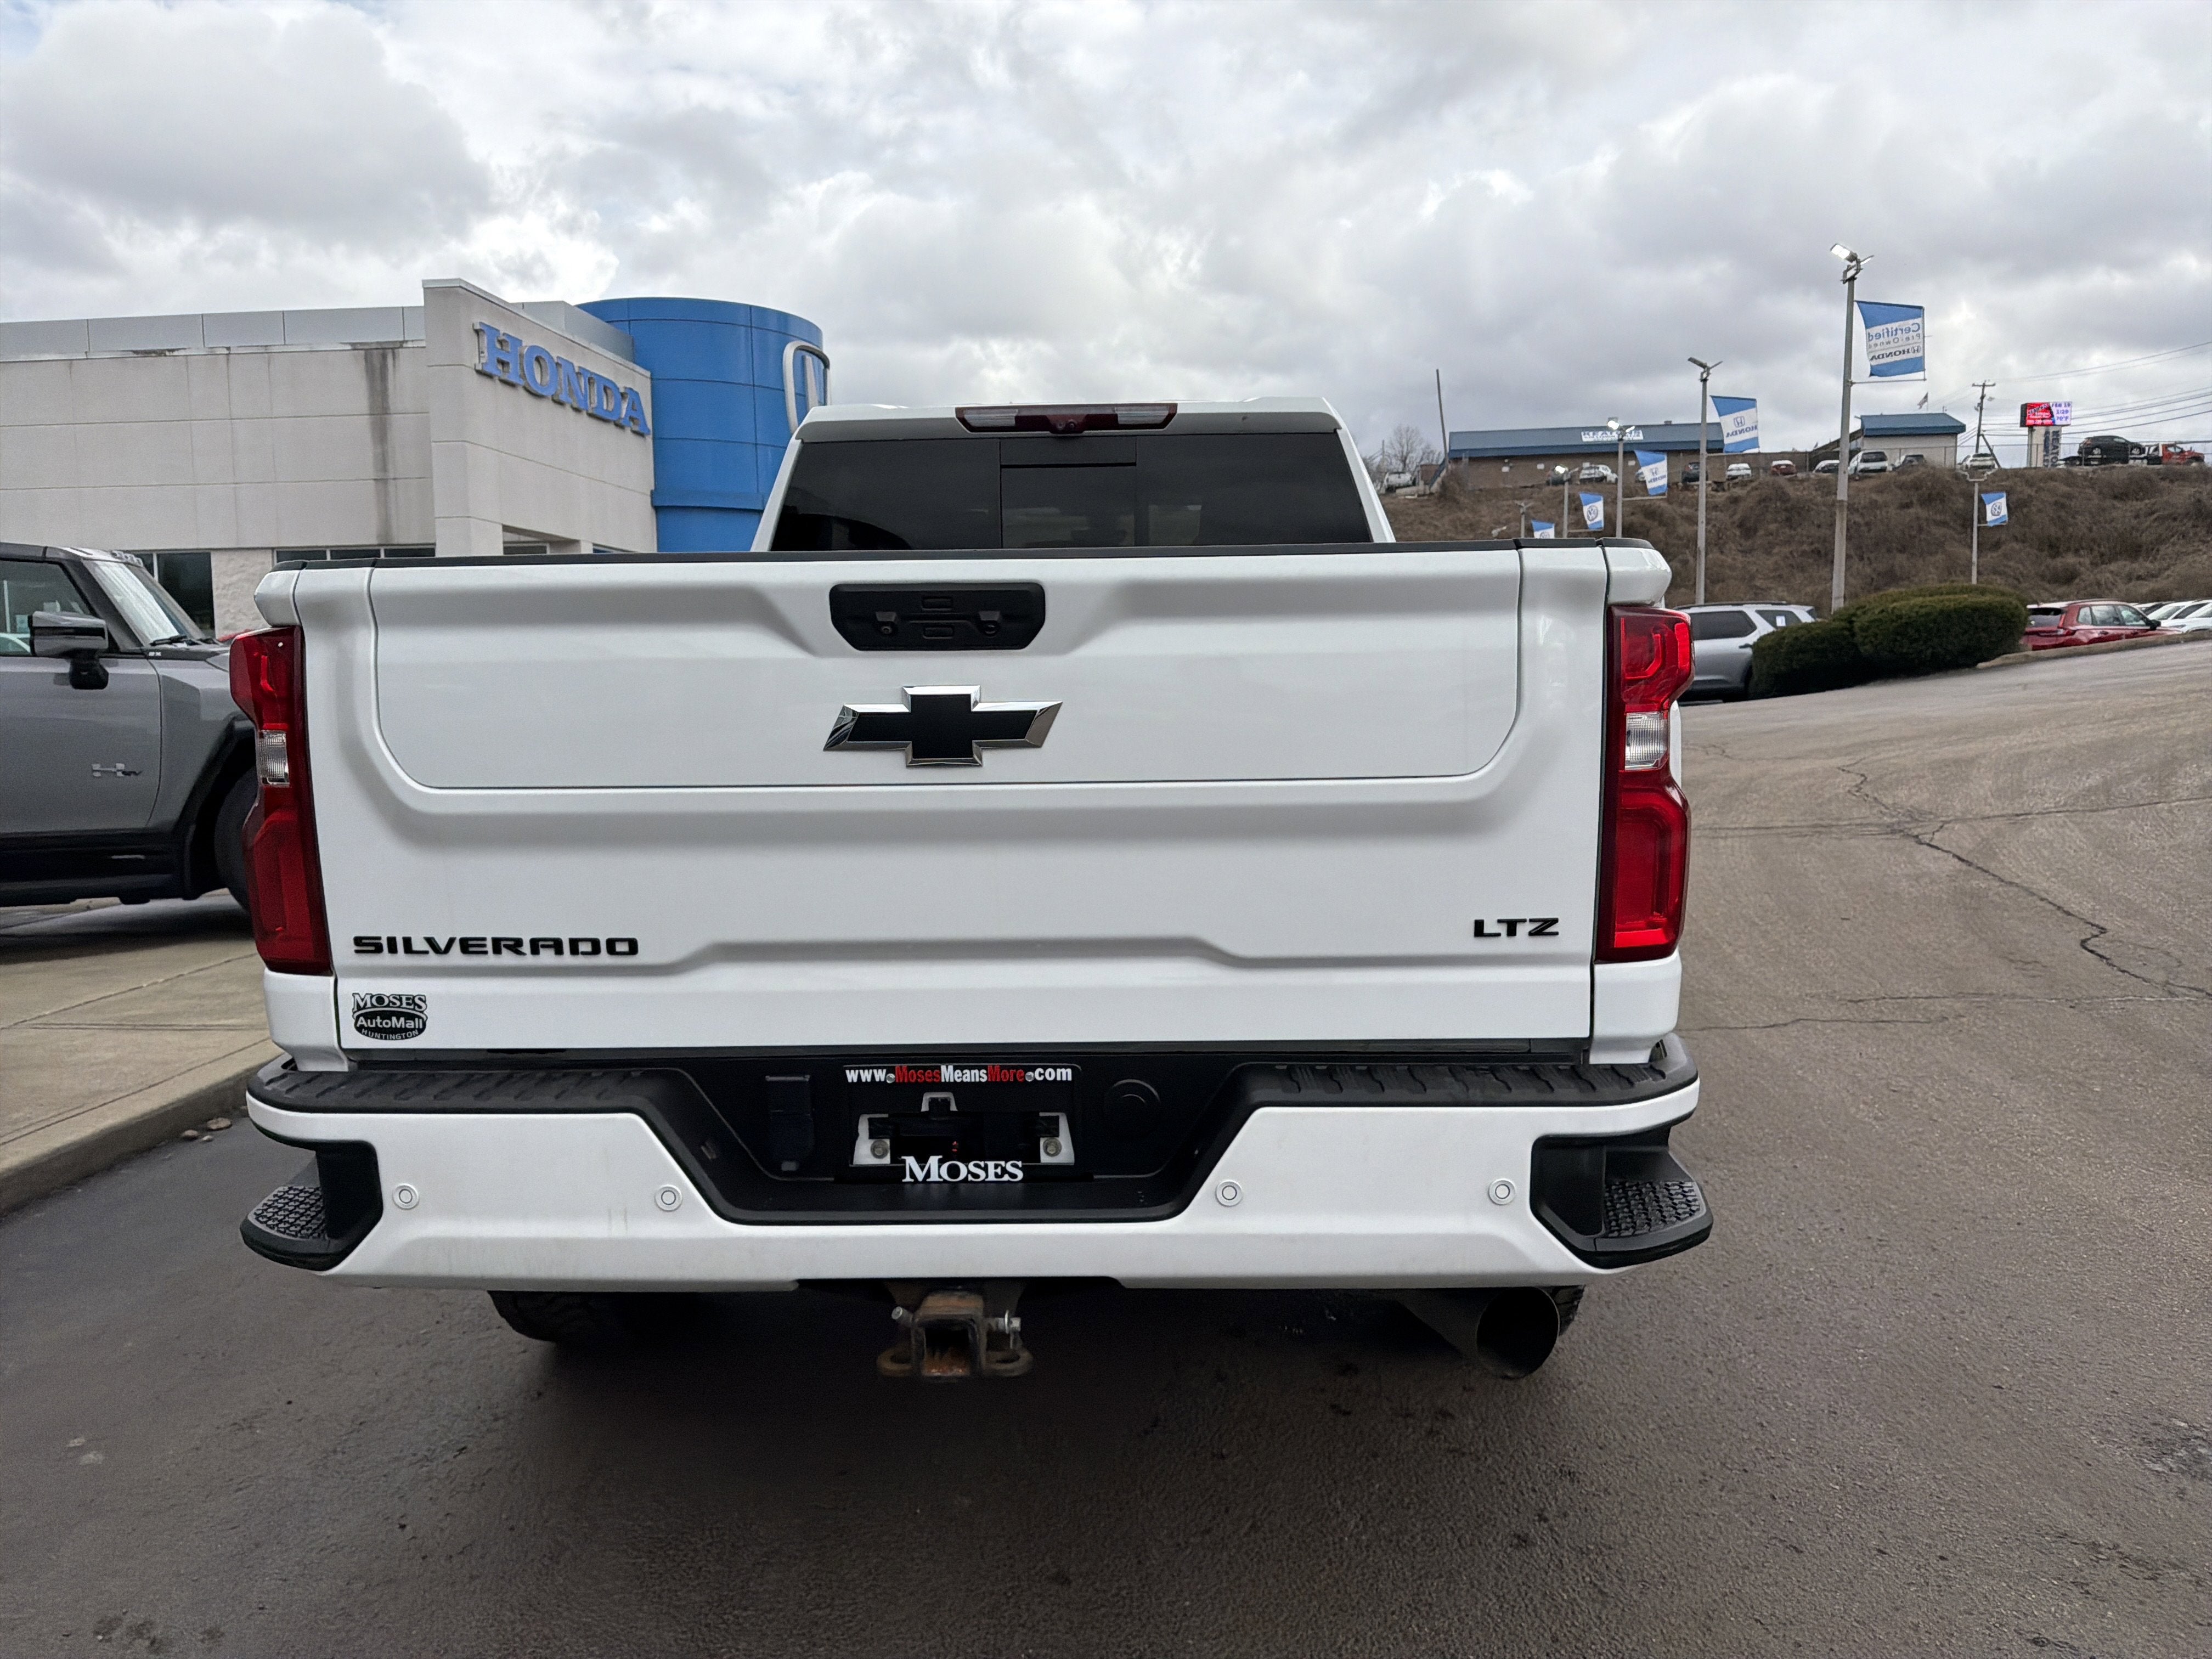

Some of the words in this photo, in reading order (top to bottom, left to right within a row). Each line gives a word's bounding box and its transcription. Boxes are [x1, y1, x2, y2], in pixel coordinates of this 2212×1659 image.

[473, 321, 650, 436] HONDA
[1474, 917, 1559, 938] LTZ
[353, 935, 639, 956] SILVERADO
[352, 993, 427, 1012] MOSES
[357, 1015, 423, 1029] AutoMall
[362, 1028, 419, 1040] HUNTINGTON
[845, 1065, 1072, 1084] www.MosesMeansMore.com
[901, 1155, 1024, 1182] MOSES
